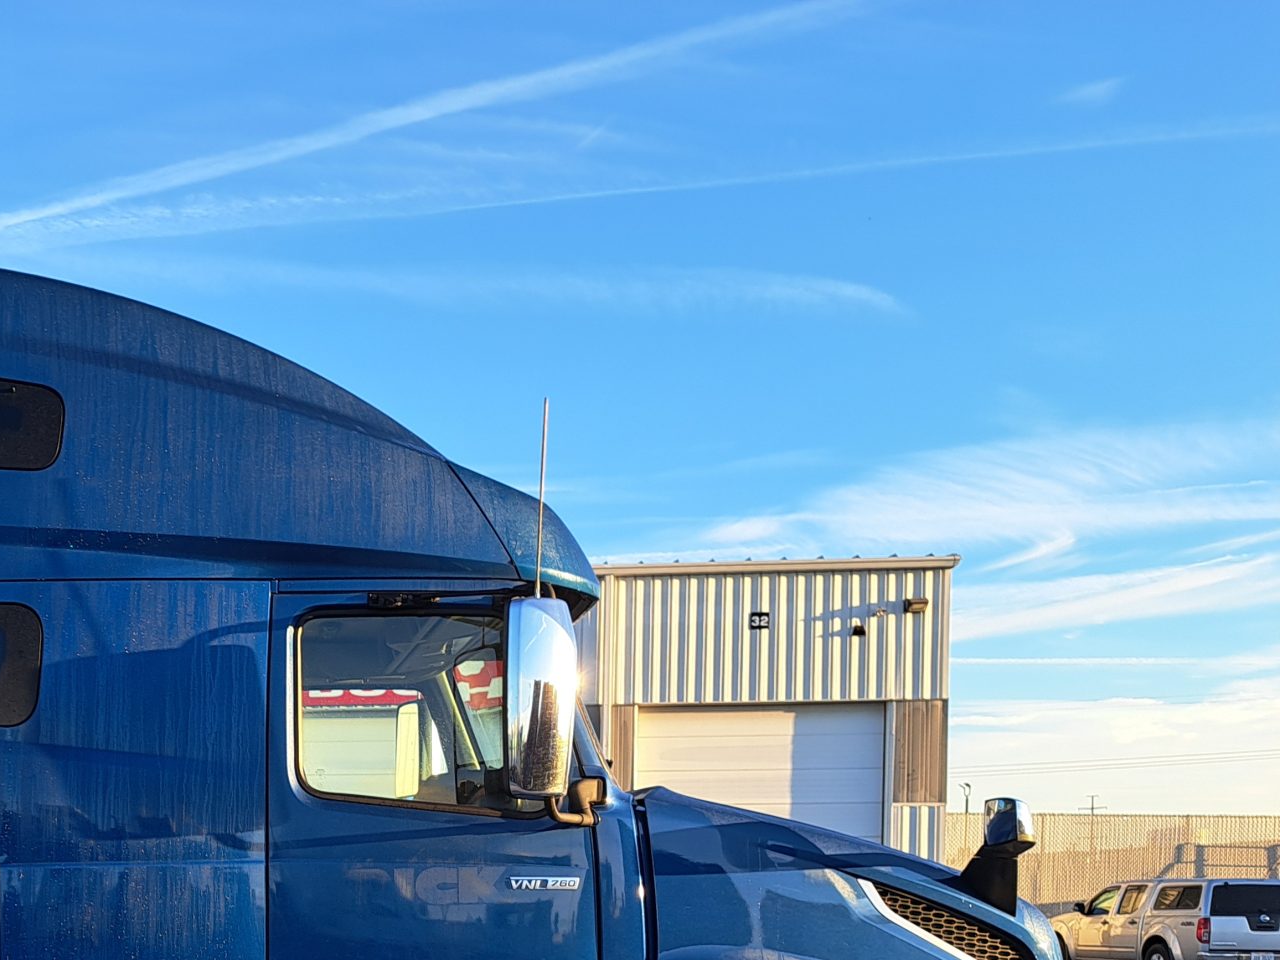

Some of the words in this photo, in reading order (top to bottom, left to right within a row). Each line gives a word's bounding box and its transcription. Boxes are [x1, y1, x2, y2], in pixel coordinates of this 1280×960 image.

[751, 616, 769, 627] 32
[510, 879, 547, 890] VNL
[551, 879, 577, 888] 760
